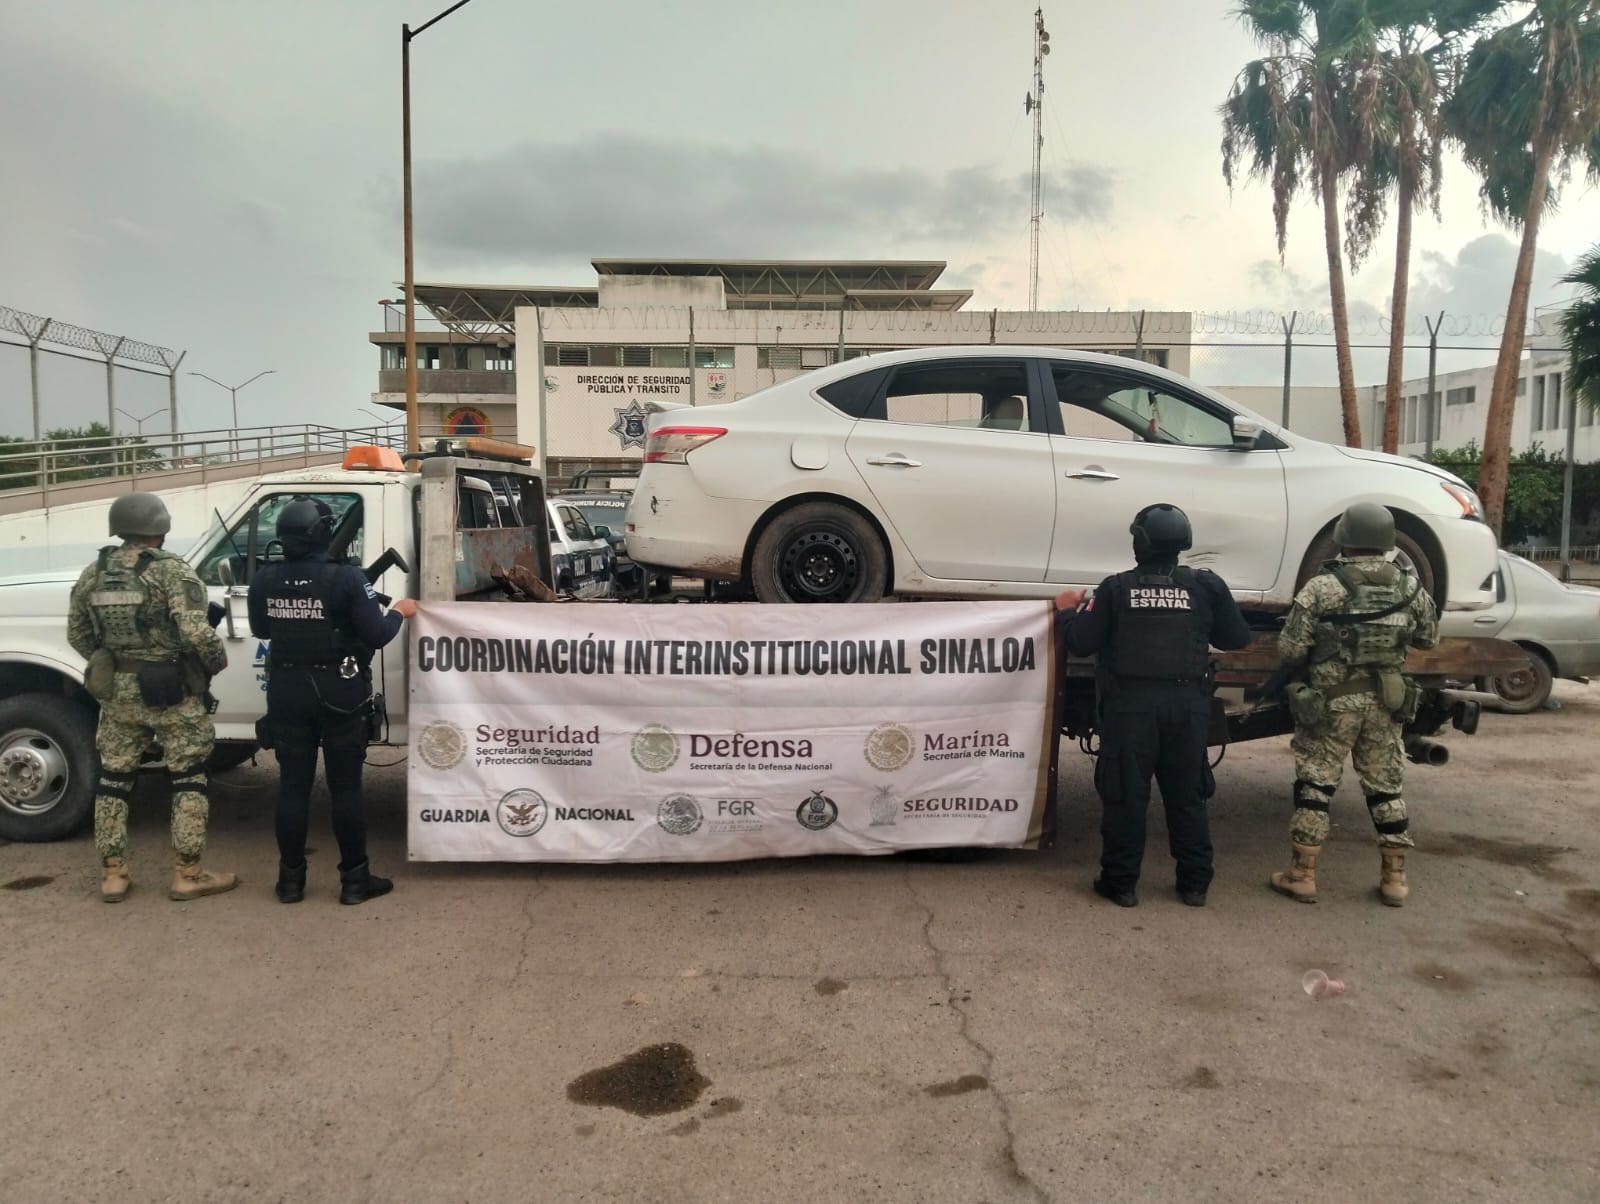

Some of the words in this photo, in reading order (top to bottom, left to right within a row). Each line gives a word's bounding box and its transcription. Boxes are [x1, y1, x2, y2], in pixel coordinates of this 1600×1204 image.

[628, 376, 638, 384] DE
[643, 376, 691, 384] SEGURIDAD
[627, 385, 633, 393] Y
[1130, 588, 1190, 599] POLICÍA
[267, 598, 324, 608] POLICÍA
[1130, 599, 1191, 609] ESTATAL
[267, 608, 325, 619] MUNICIPAL
[418, 632, 614, 674] COORDINACIÓN
[624, 640, 911, 676] INTERINSTITUCIONAL
[920, 637, 1036, 674] SINALOA
[476, 724, 600, 747] Seguridad
[924, 730, 1009, 751] Marina
[690, 733, 813, 758] Defensa
[476, 746, 526, 755] Secretaría
[529, 747, 541, 755] de
[544, 748, 592, 757] Seguridad
[923, 750, 971, 761] Secretaría
[974, 749, 987, 757] de
[990, 749, 1025, 759] Marina
[476, 758, 482, 767] y
[485, 756, 539, 765] Protección
[542, 757, 592, 766] Ciudadana
[690, 762, 733, 770] Secretaría
[718, 800, 755, 816] FGR
[903, 798, 1018, 812] SEGURIDAD
[420, 808, 490, 823] GUARDIA
[555, 808, 635, 822] NACIONAL
